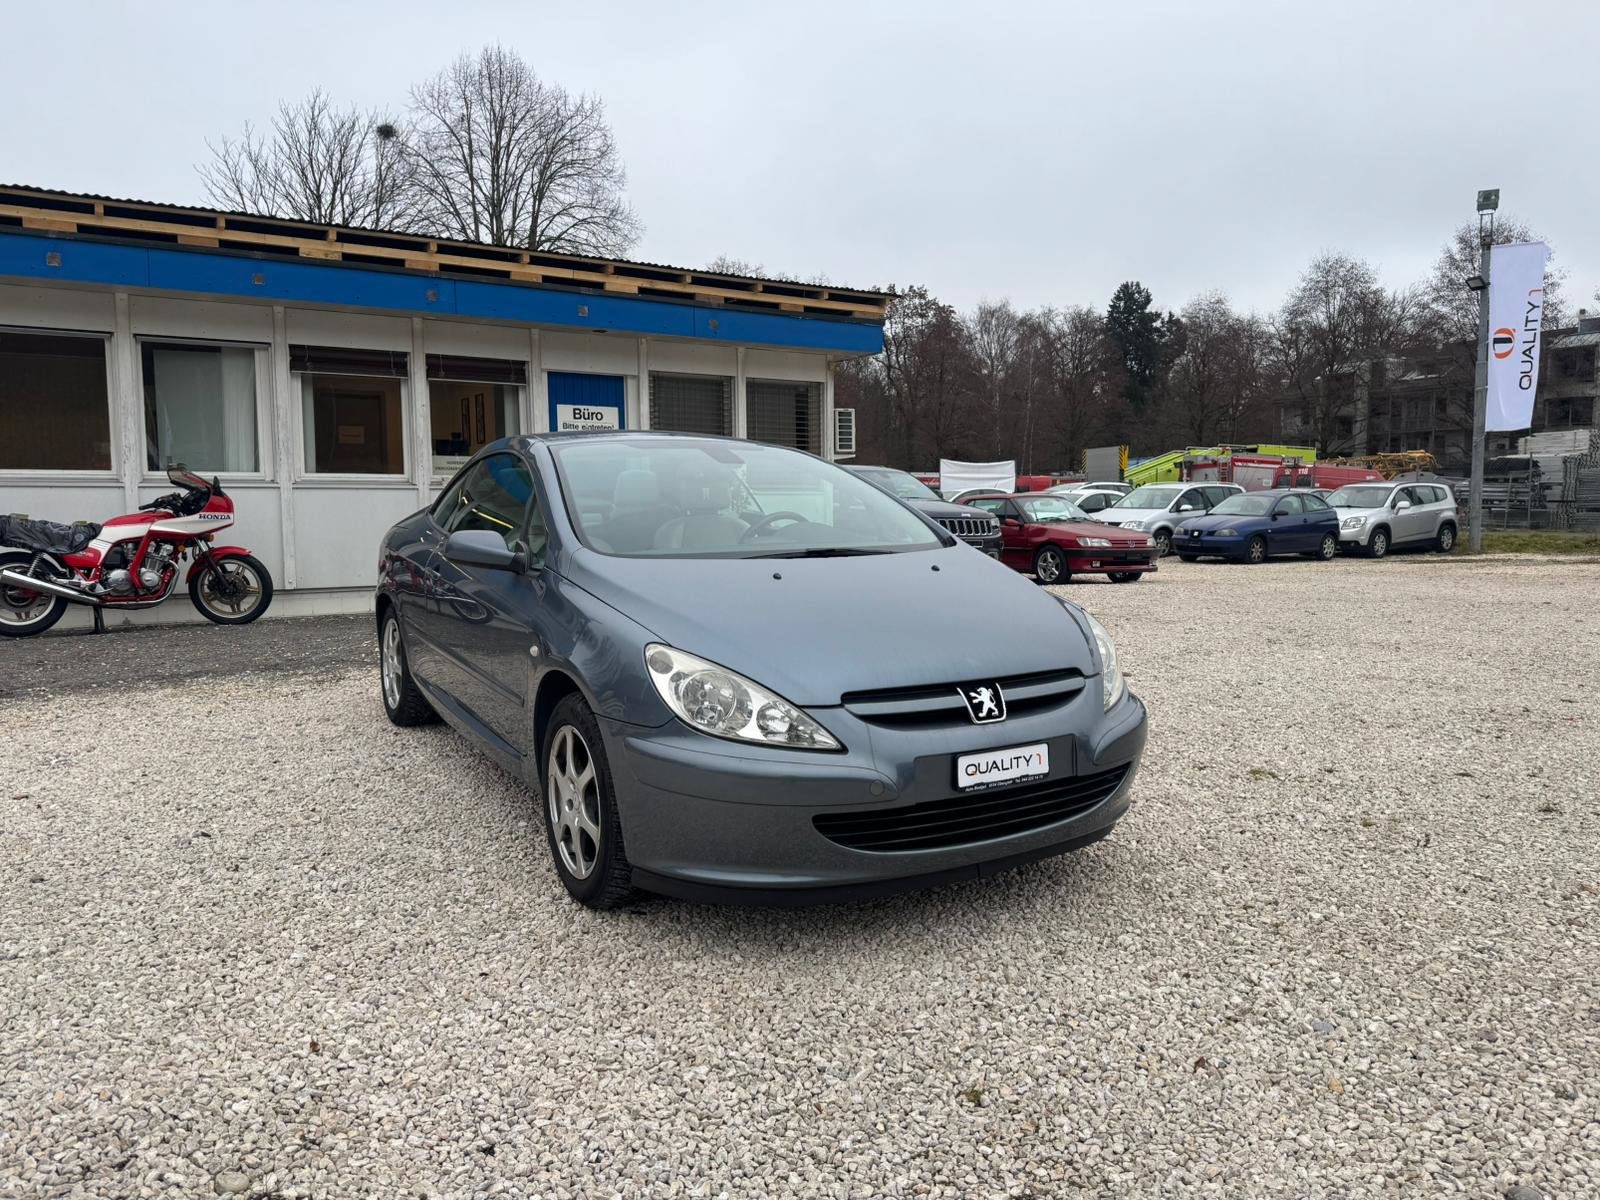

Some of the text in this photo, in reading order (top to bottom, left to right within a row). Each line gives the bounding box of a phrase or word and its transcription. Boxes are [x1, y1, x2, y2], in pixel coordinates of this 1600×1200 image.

[1518, 301, 1540, 390] QUALITY
[572, 407, 604, 421] Büro
[562, 422, 579, 430] Bitte
[965, 754, 1033, 776] QUALITY
